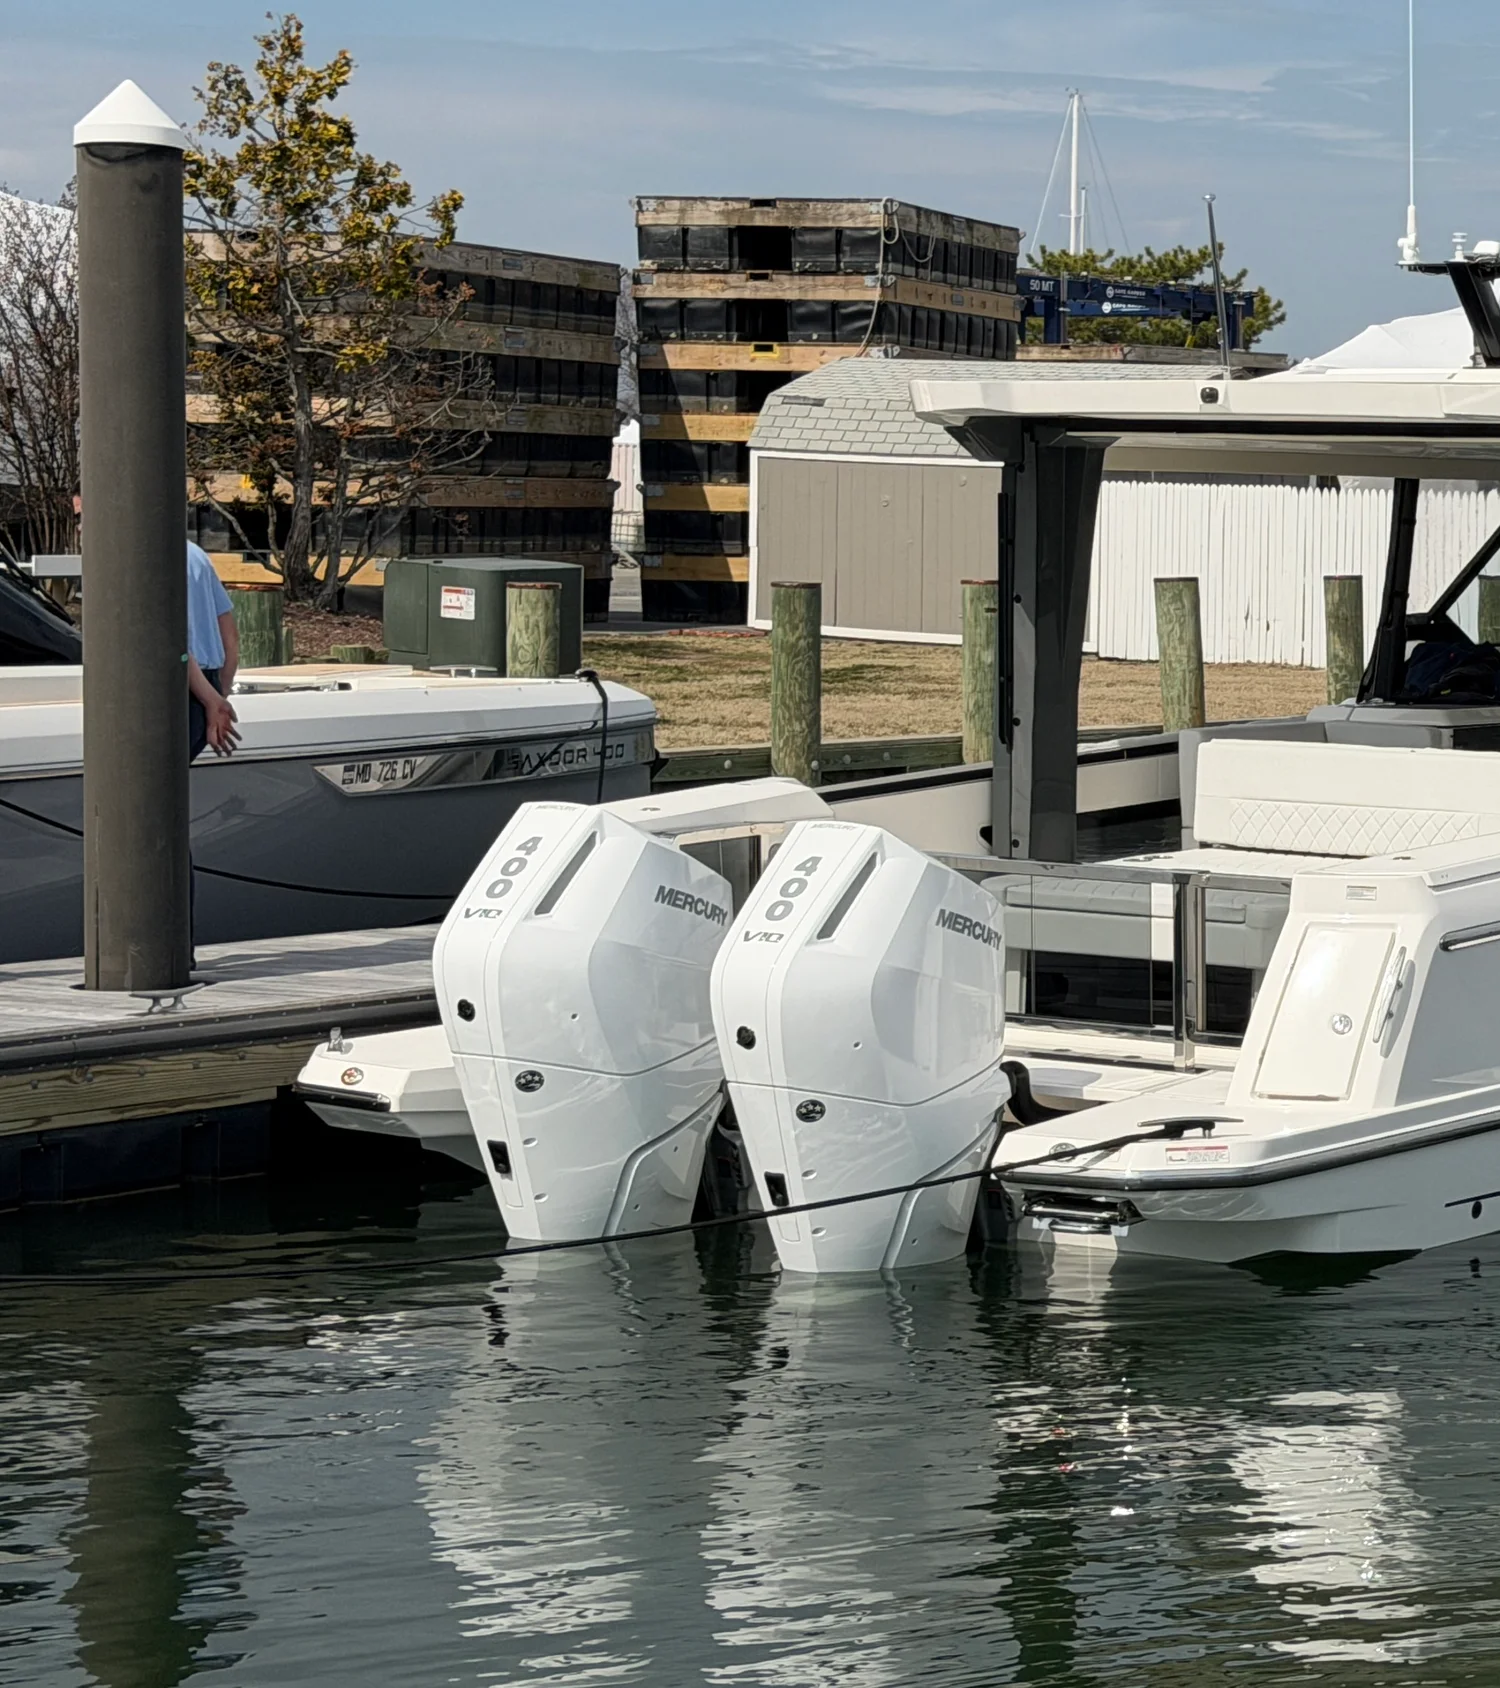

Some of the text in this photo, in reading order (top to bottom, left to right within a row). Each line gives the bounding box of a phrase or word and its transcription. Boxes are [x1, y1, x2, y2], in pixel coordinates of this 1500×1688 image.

[1029, 279, 1055, 292] 50 MT
[355, 759, 417, 784] MD 726 CV
[485, 836, 543, 899] 400
[764, 856, 823, 921] 400
[654, 885, 728, 927] MERCURY
[935, 908, 1003, 951] MERCURY
